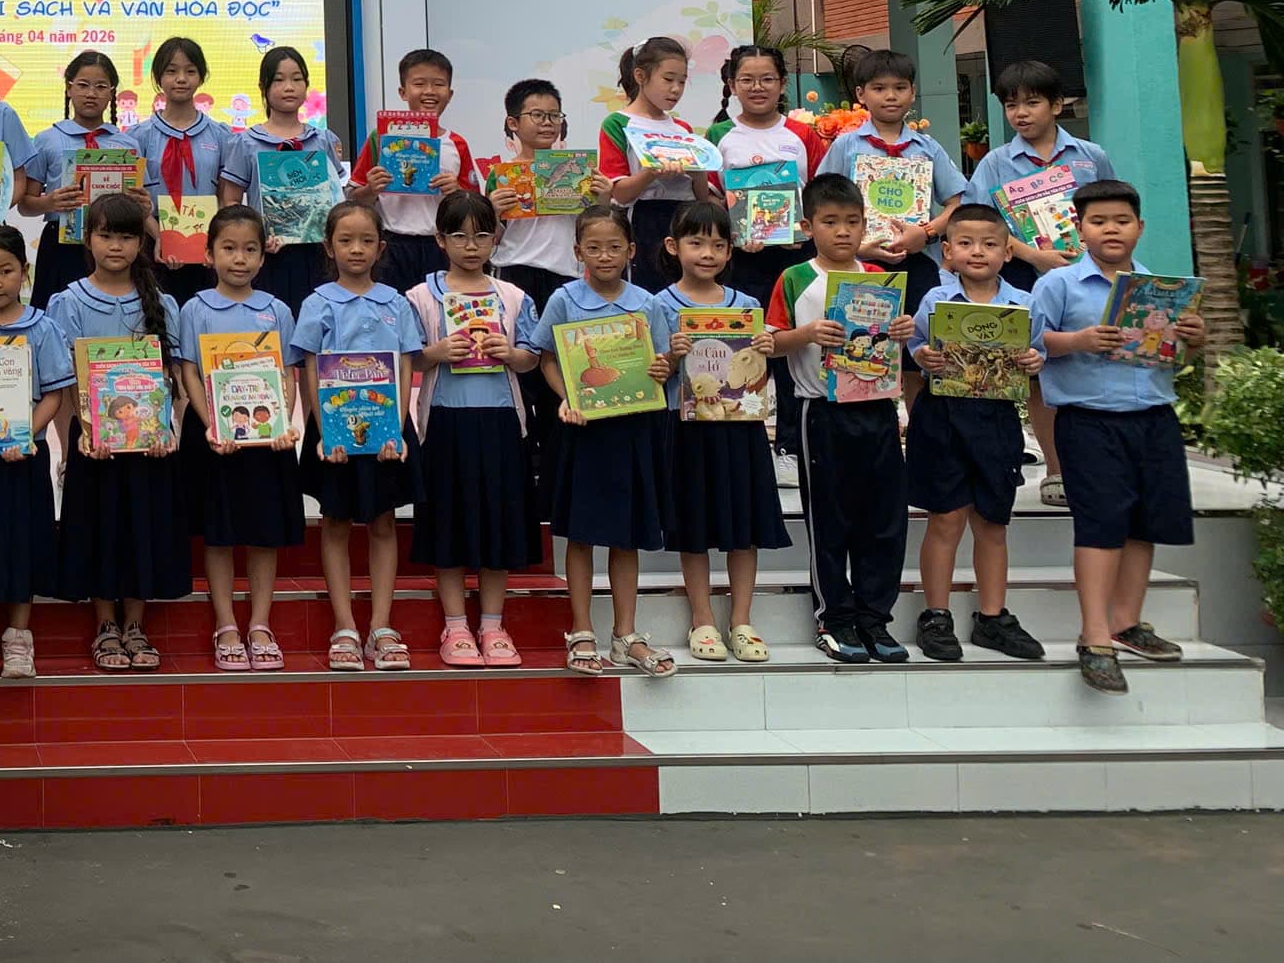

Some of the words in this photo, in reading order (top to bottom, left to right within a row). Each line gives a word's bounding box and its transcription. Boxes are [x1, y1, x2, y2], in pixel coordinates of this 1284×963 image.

[28, 30, 44, 42] 04
[50, 31, 76, 43] năm
[82, 31, 115, 43] 2026
